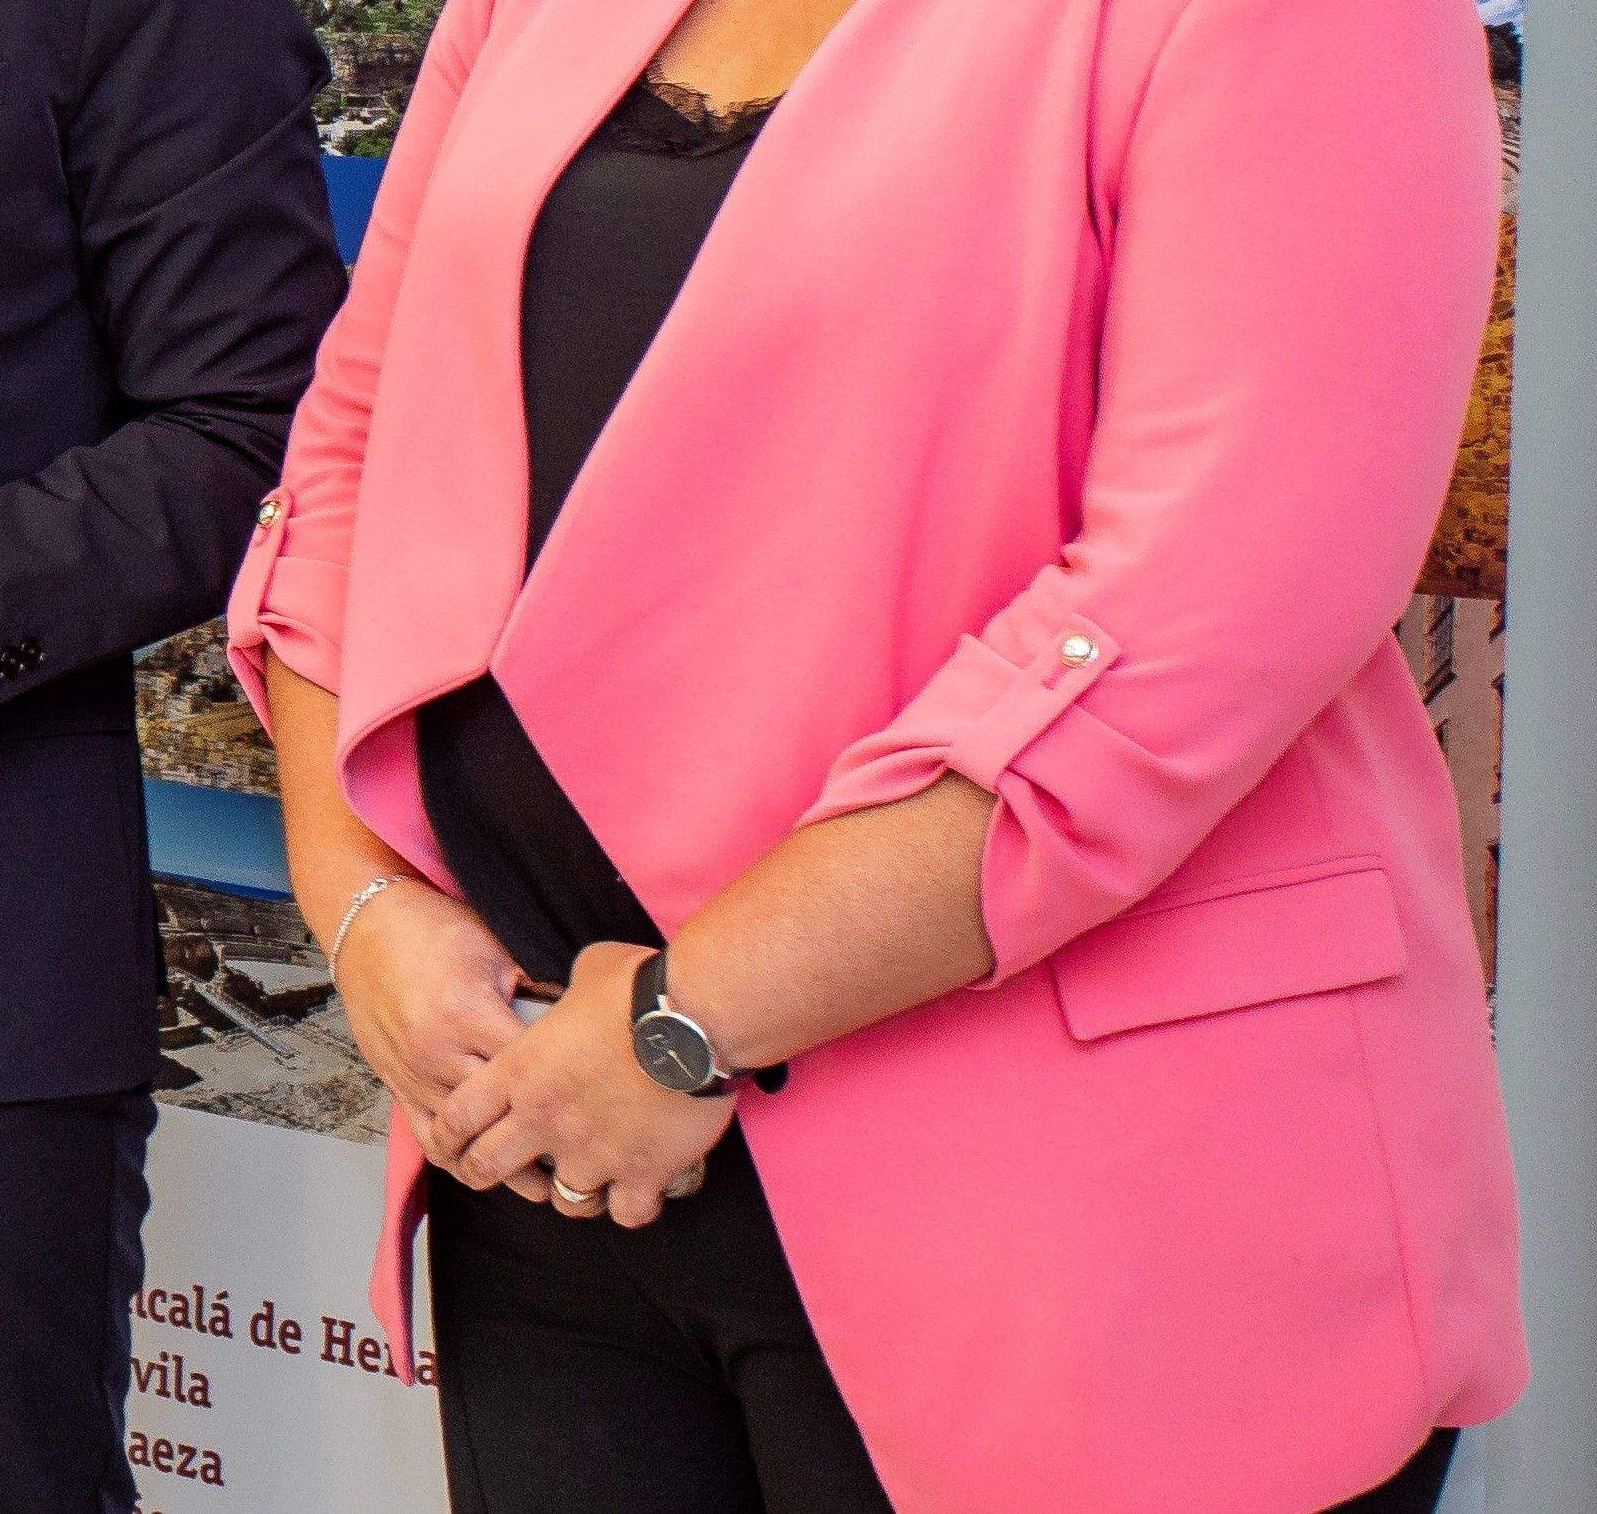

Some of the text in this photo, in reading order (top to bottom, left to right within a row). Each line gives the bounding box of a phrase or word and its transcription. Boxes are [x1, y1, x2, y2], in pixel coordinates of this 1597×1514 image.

[130, 1284, 234, 1339] lcalá
[249, 1300, 303, 1355] de
[130, 1351, 212, 1409] vila
[127, 1430, 225, 1487] aeza
